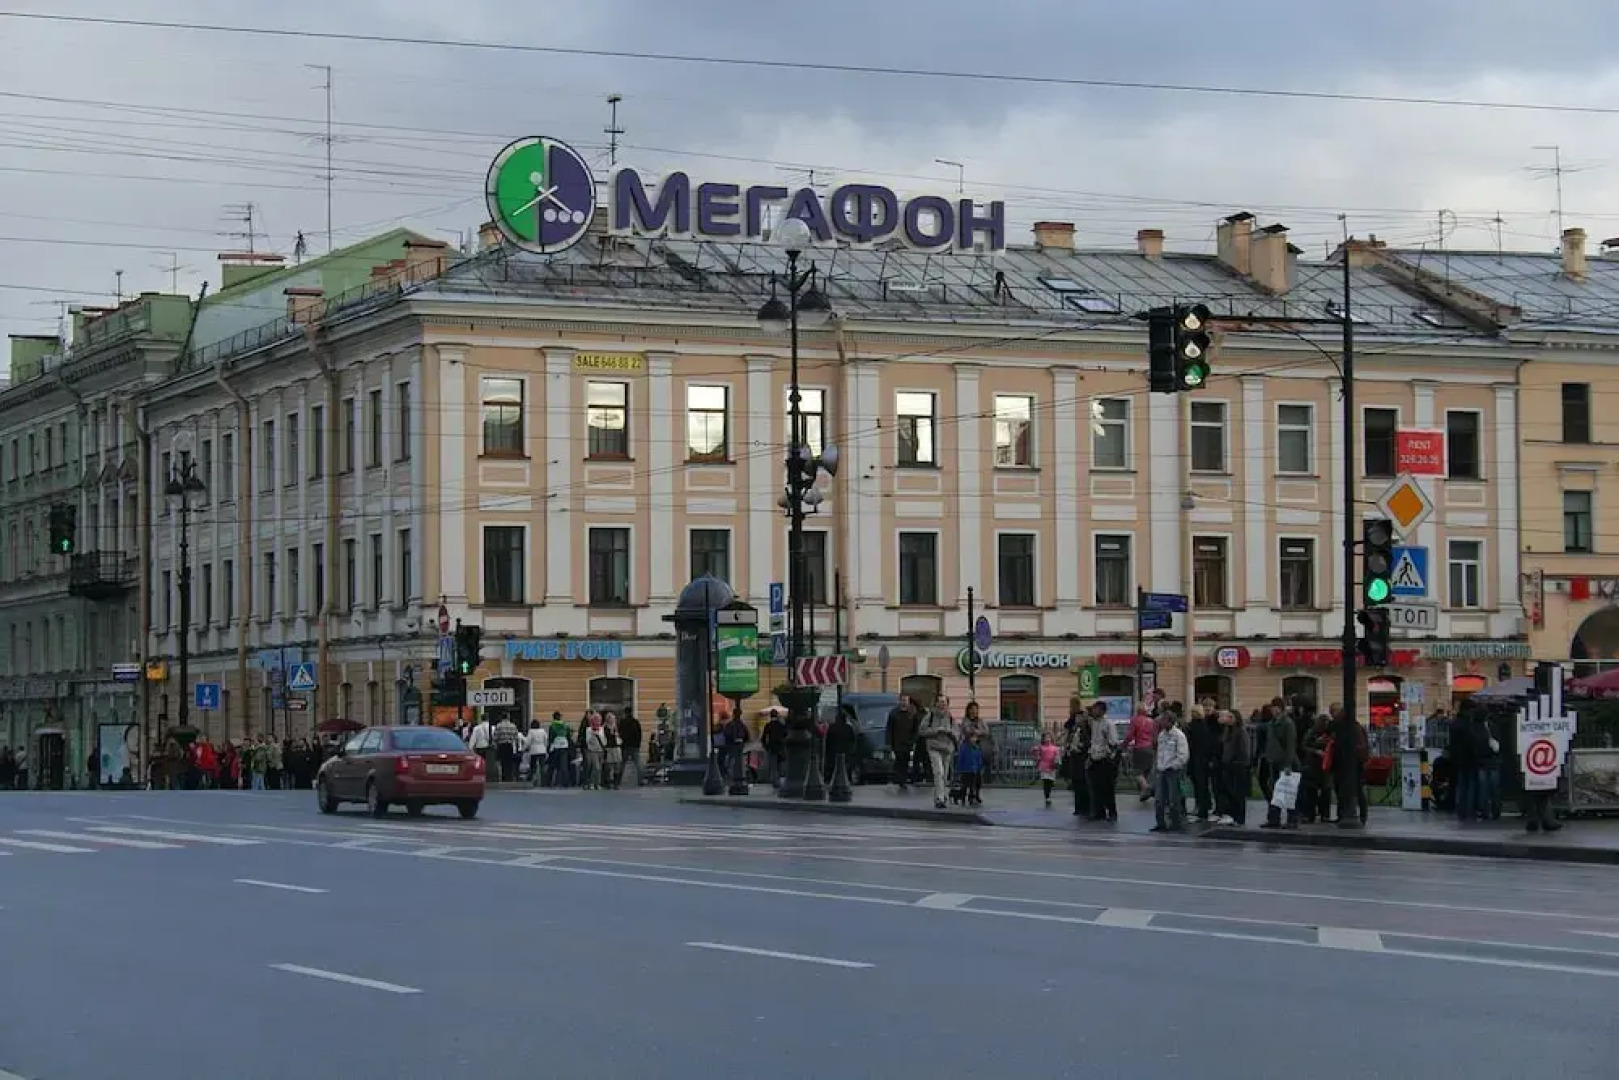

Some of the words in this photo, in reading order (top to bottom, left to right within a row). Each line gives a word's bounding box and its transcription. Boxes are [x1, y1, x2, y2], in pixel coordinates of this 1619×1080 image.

[615, 168, 1005, 250] МЕГАФОН
[1393, 608, 1428, 625] ТОП
[986, 652, 1071, 668] МЕГАФОН
[474, 691, 508, 703] СТОП
